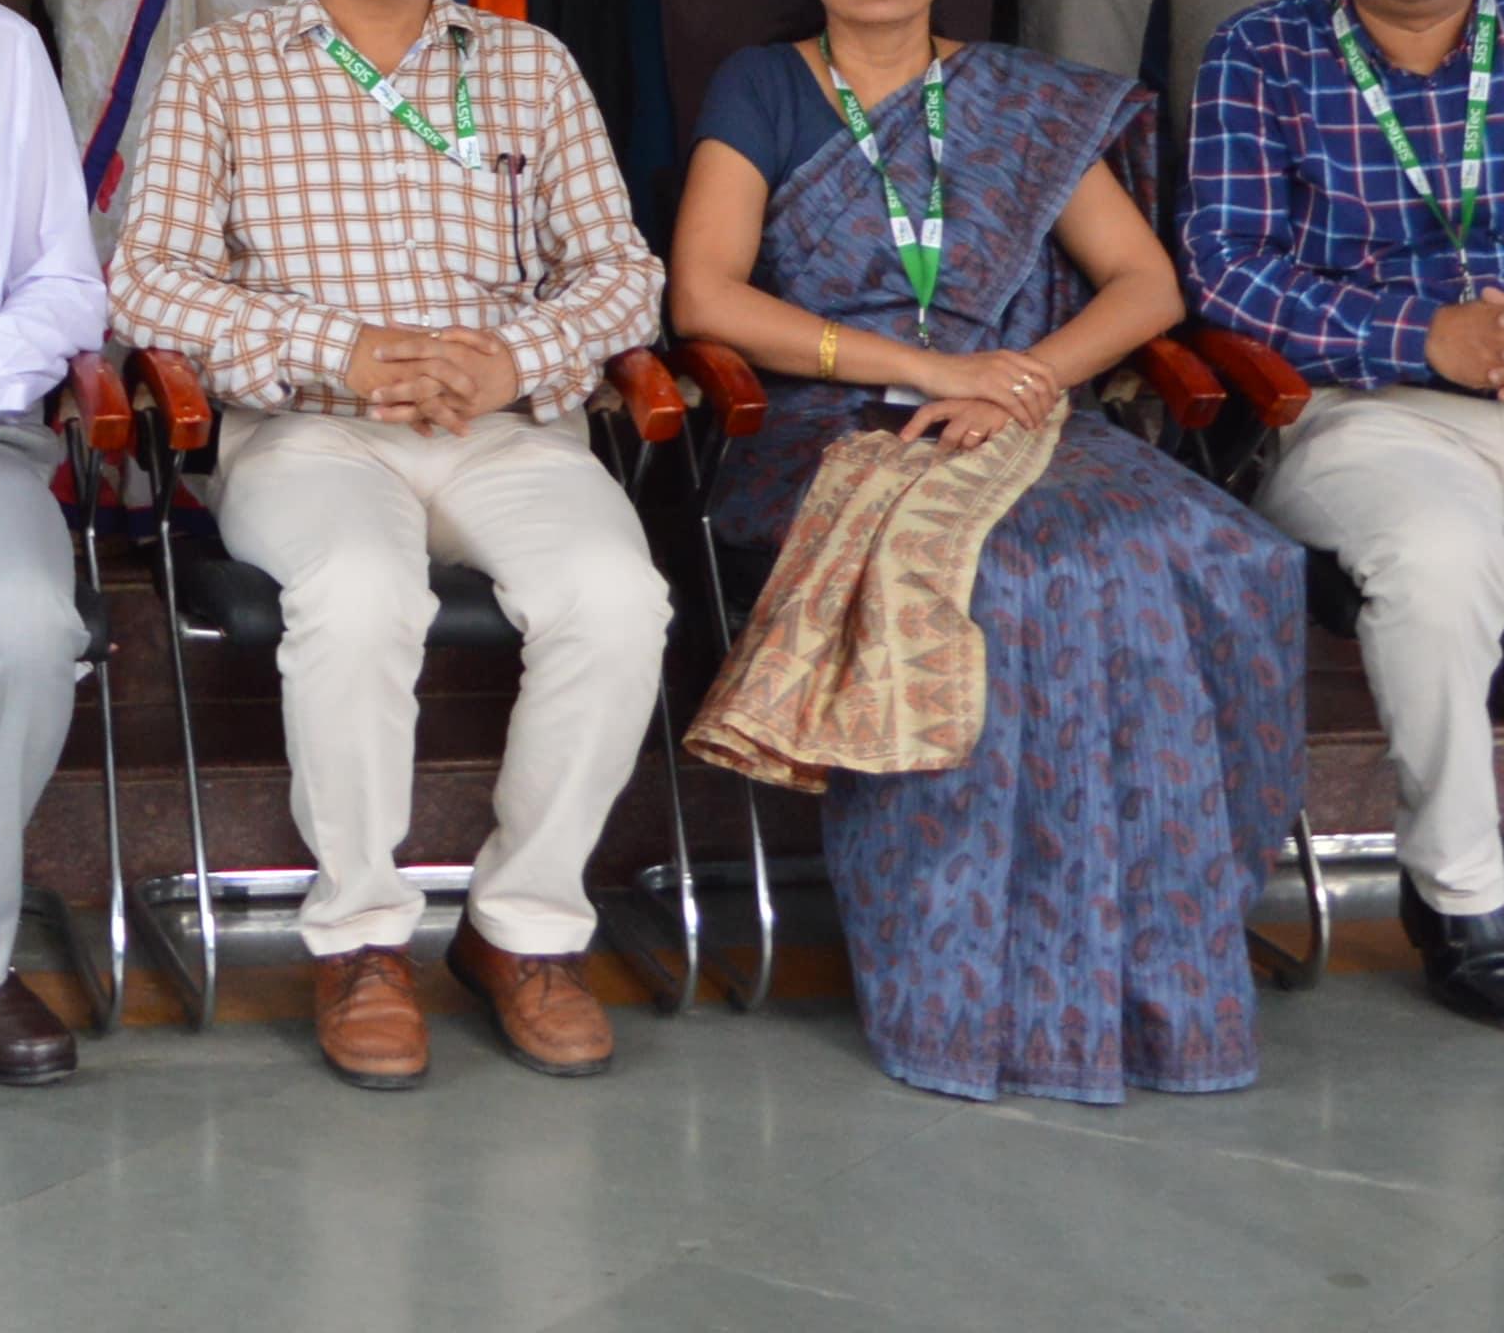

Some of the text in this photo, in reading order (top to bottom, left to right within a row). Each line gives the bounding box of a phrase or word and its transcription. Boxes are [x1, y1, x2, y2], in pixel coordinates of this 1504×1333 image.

[335, 45, 373, 84] SISTec
[403, 107, 442, 146] SISTec
[926, 89, 941, 131] SISTec
